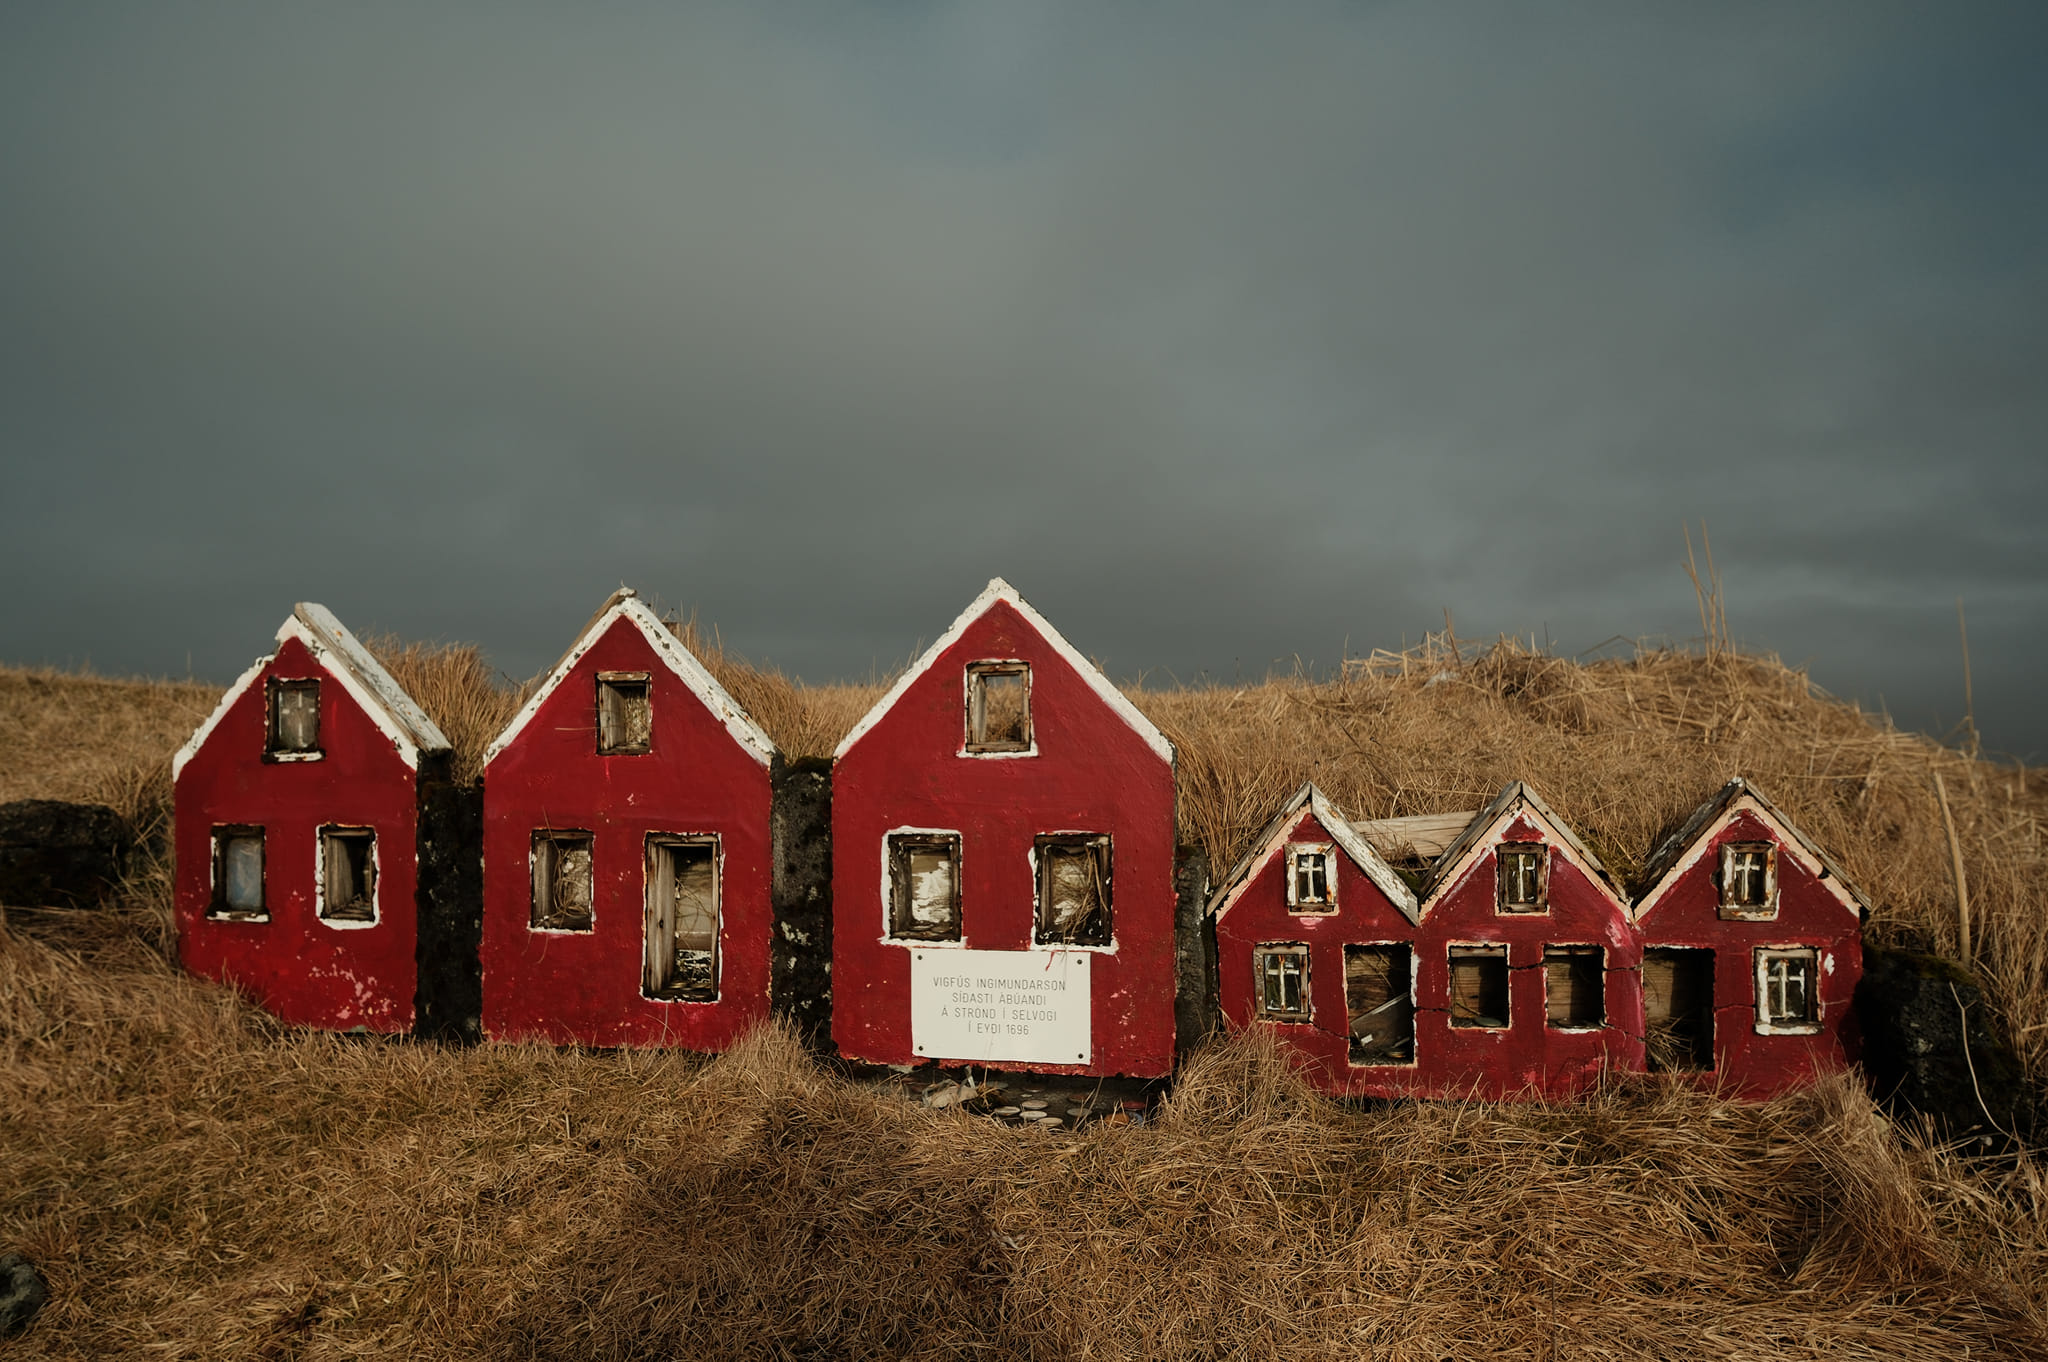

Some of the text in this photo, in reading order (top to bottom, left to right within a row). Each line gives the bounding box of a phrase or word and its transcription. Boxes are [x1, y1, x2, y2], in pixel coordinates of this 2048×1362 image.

[933, 975, 1066, 991] VIGFÚS INGIMUNDARSON
[952, 991, 1046, 1006] SÍÐASTI ÁBÚANDI
[941, 1004, 949, 1017] Á
[1012, 1009, 1057, 1021] SELVOGI
[1006, 1024, 1029, 1035] 1696
